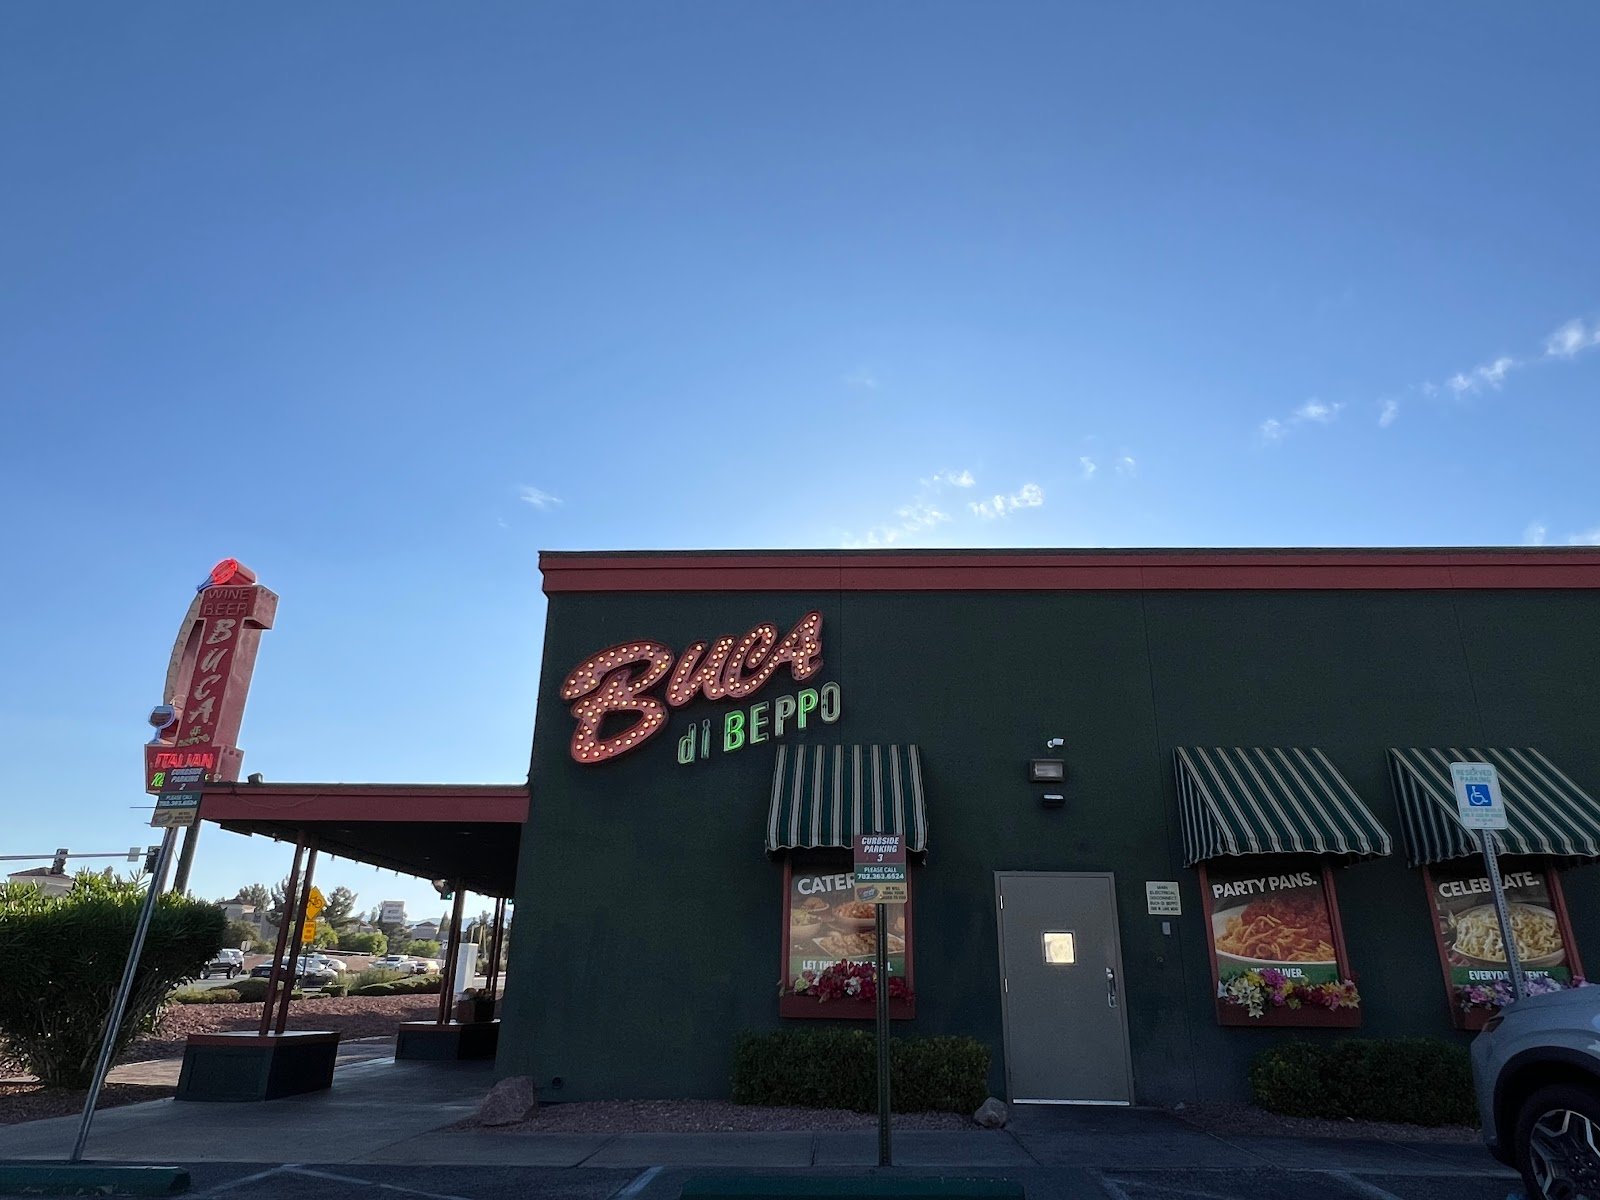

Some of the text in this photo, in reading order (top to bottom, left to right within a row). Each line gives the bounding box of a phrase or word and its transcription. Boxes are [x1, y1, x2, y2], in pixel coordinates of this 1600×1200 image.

[209, 588, 249, 600] WINE
[203, 602, 247, 616] BEER
[188, 618, 237, 725] BUCA
[560, 609, 824, 764] BUCA
[677, 681, 842, 765] di BEPPO
[154, 752, 215, 769] ITALIAN
[170, 775, 200, 783] PARKING
[861, 836, 900, 845] CURBSIDE
[863, 844, 898, 853] PARKING
[876, 853, 884, 862] 3
[1212, 871, 1318, 899] PARTY PANS.
[1438, 871, 1540, 898] CELEBATE.
[802, 960, 818, 970] LET
[1468, 970, 1510, 981] EVERYDA
